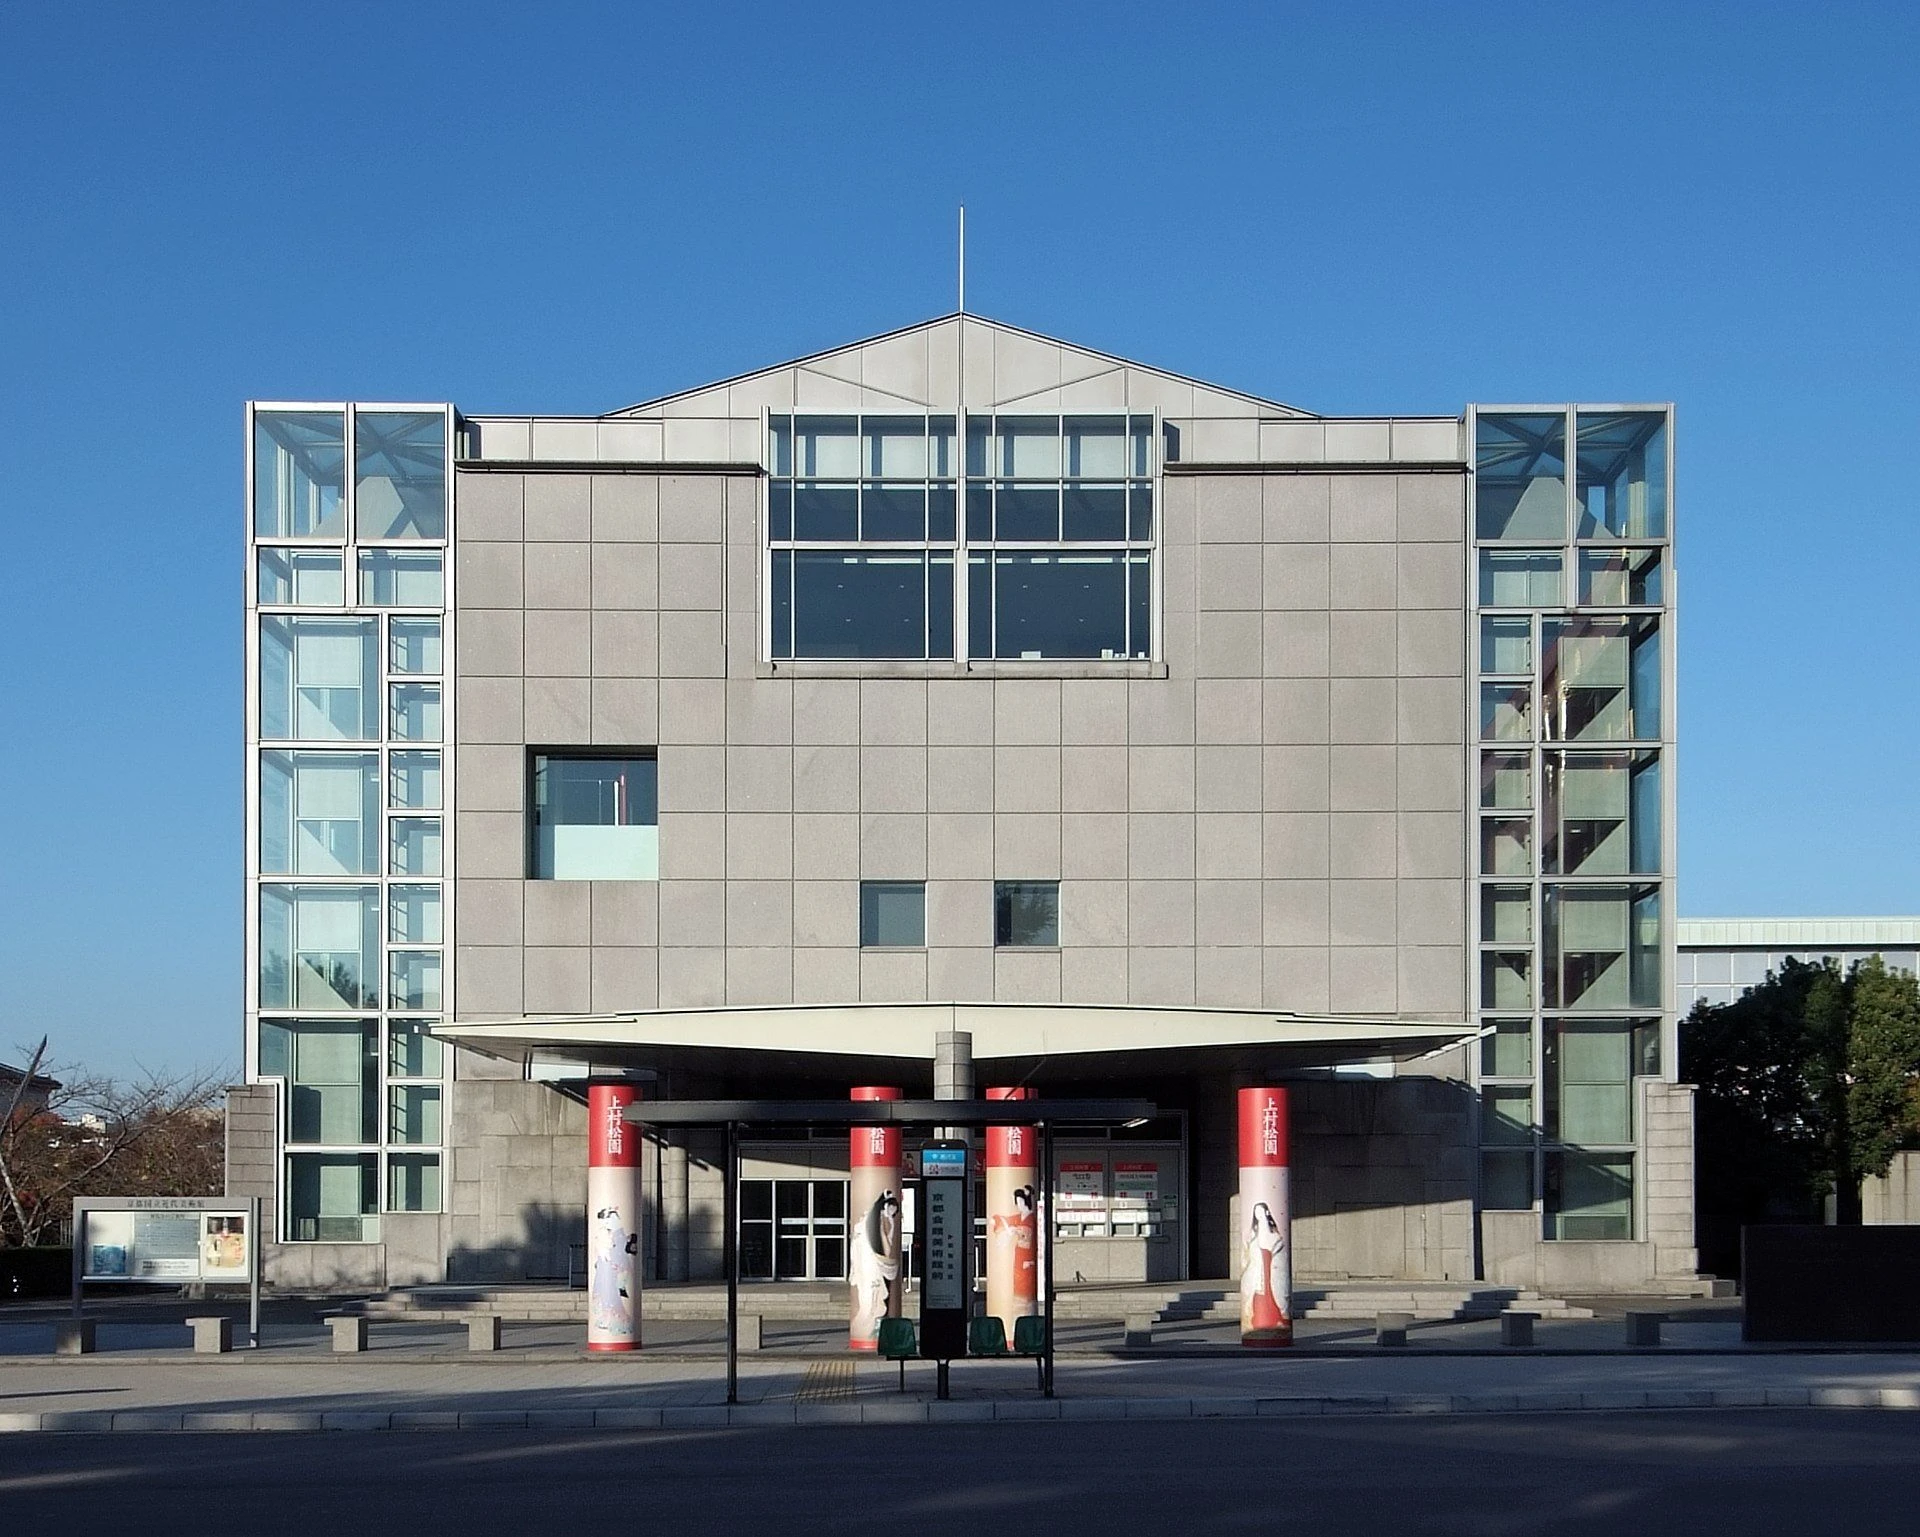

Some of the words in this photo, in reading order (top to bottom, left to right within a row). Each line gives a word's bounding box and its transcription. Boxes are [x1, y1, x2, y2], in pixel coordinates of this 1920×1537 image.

[607, 1095, 623, 1155] 上村松園
[1263, 1097, 1278, 1156] 上村松園
